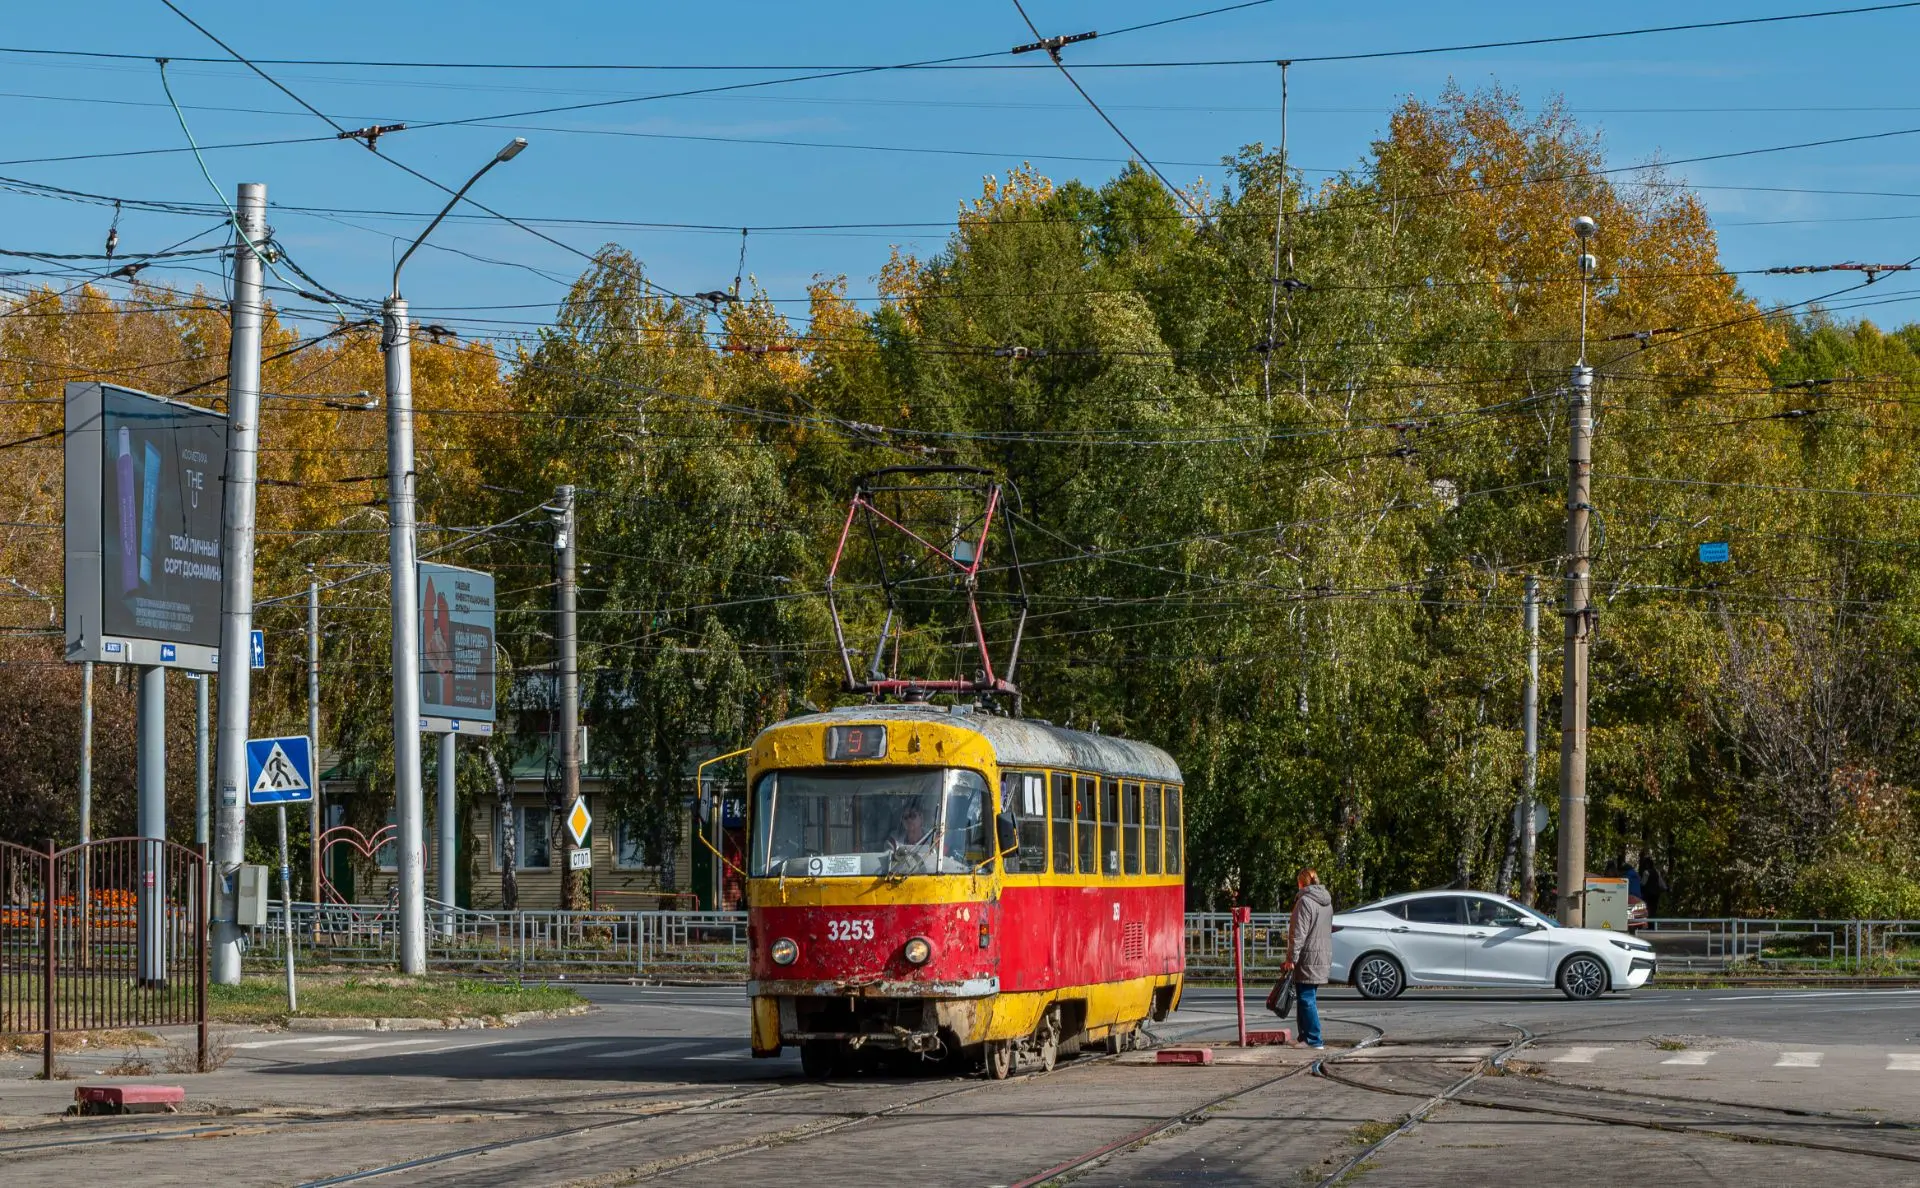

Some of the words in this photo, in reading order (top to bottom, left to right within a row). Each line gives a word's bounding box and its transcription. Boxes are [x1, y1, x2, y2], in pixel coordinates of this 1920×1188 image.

[186, 469, 203, 490] THE
[191, 490, 198, 508] U
[170, 533, 188, 553] ТВОЙ
[188, 538, 219, 558] ЛИЧНЫЙ
[164, 557, 182, 576] СОРТ
[849, 729, 863, 752] 9
[573, 852, 589, 866] СТОП
[810, 857, 823, 876] 9
[827, 919, 875, 941] 3253
